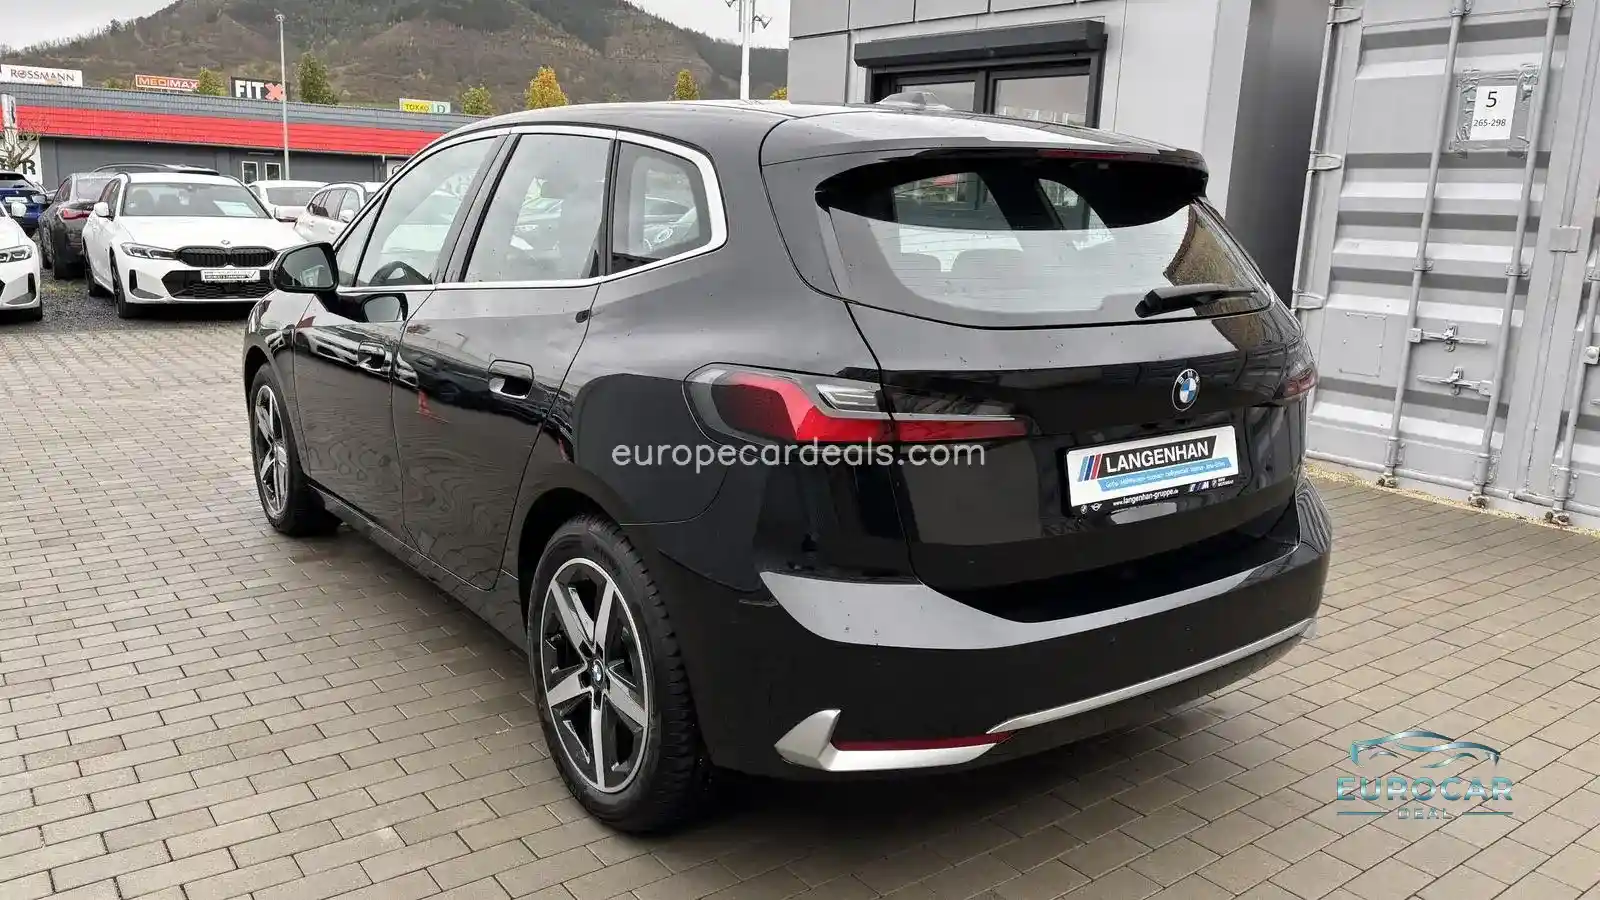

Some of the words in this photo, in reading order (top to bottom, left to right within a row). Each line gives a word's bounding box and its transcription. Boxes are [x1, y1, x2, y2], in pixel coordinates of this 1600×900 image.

[10, 69, 75, 82] ROSSMANN
[139, 77, 198, 89] MEDIMAX
[1485, 91, 1498, 108] 5
[1473, 118, 1507, 127] 265-298
[1105, 440, 1210, 474] LANGENHAN
[1112, 488, 1180, 507] www.langenhan-gruppe.de
